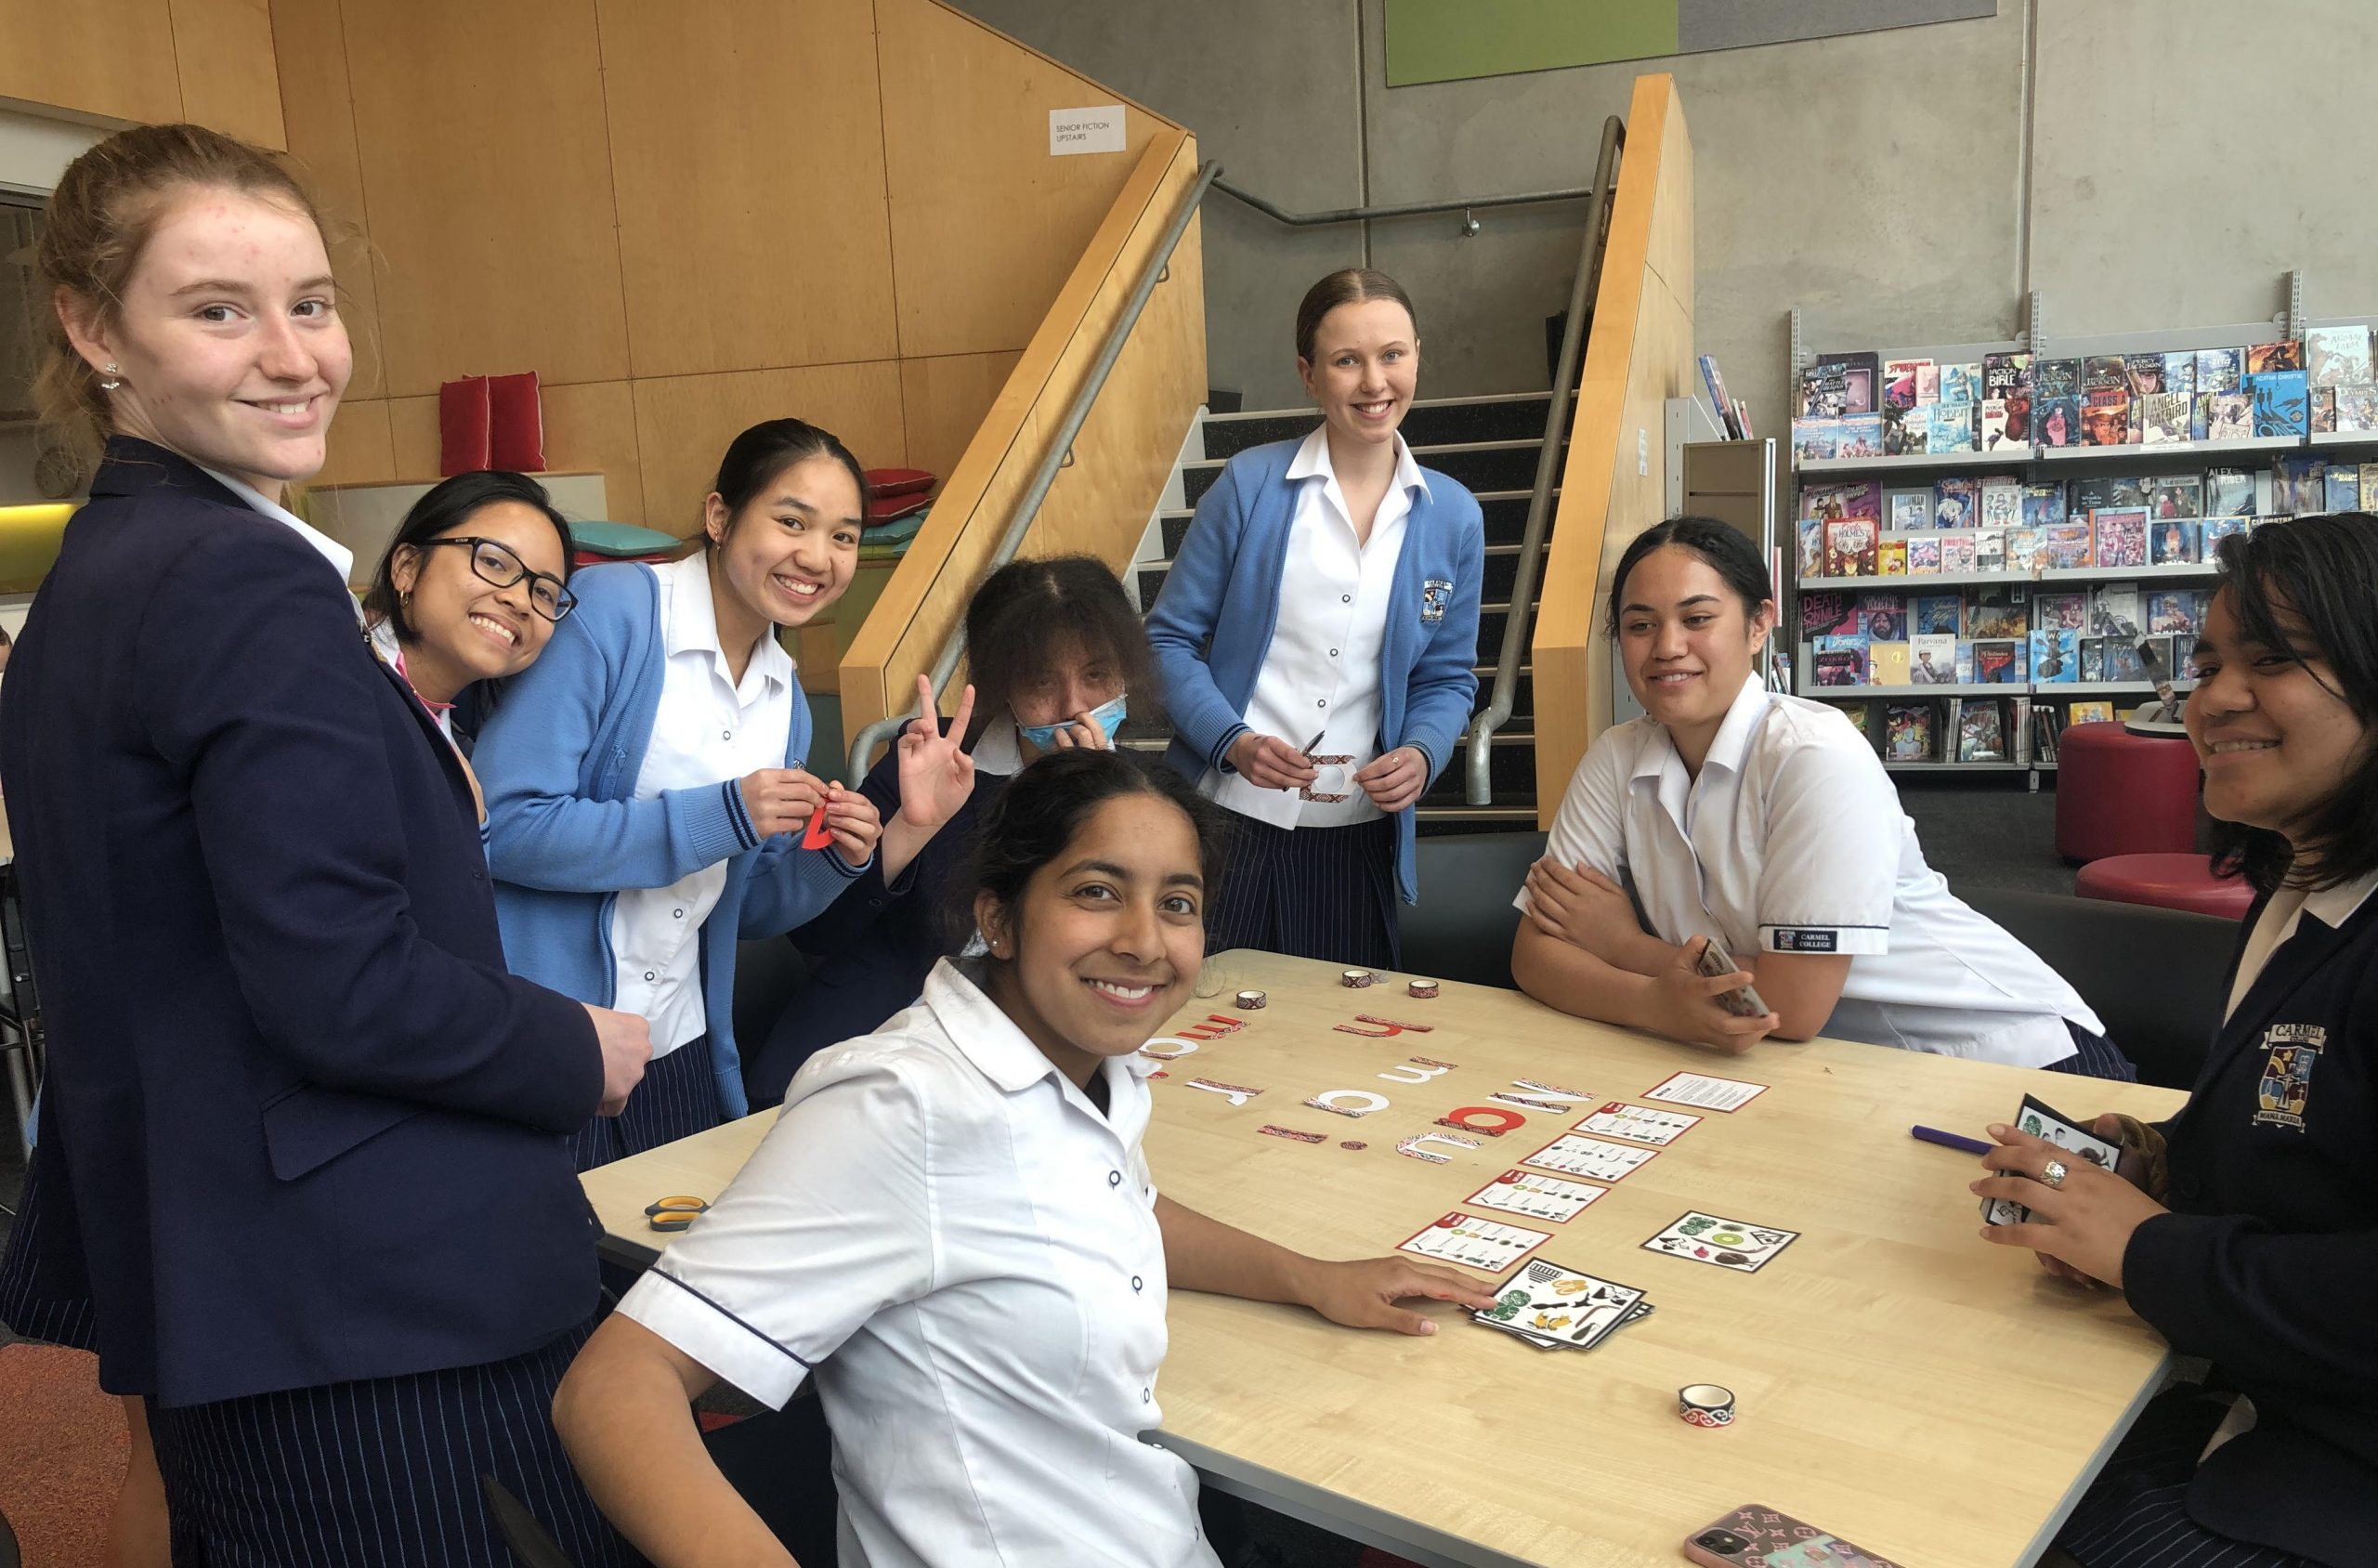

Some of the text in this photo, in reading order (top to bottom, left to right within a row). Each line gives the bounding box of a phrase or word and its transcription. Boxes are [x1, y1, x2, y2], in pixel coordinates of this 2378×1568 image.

[1056, 122, 1110, 132] SENIOR FICTION
[1056, 133, 1087, 142] UPSTAIRS
[2124, 361, 2162, 371] JACKSON
[1989, 374, 2016, 385] BIBLE
[2084, 375, 2121, 385] JACKSON
[2093, 395, 2126, 407] CLASS A
[2150, 391, 2182, 412] ANGEL
[1933, 408, 1969, 421] HOBBIT
[2208, 467, 2233, 477] ALEX
[2220, 475, 2246, 485] RIDER
[1838, 529, 1865, 538] HOLMES
[1804, 593, 1842, 612] DEATH
[2276, 1025, 2321, 1039] CARMEL
